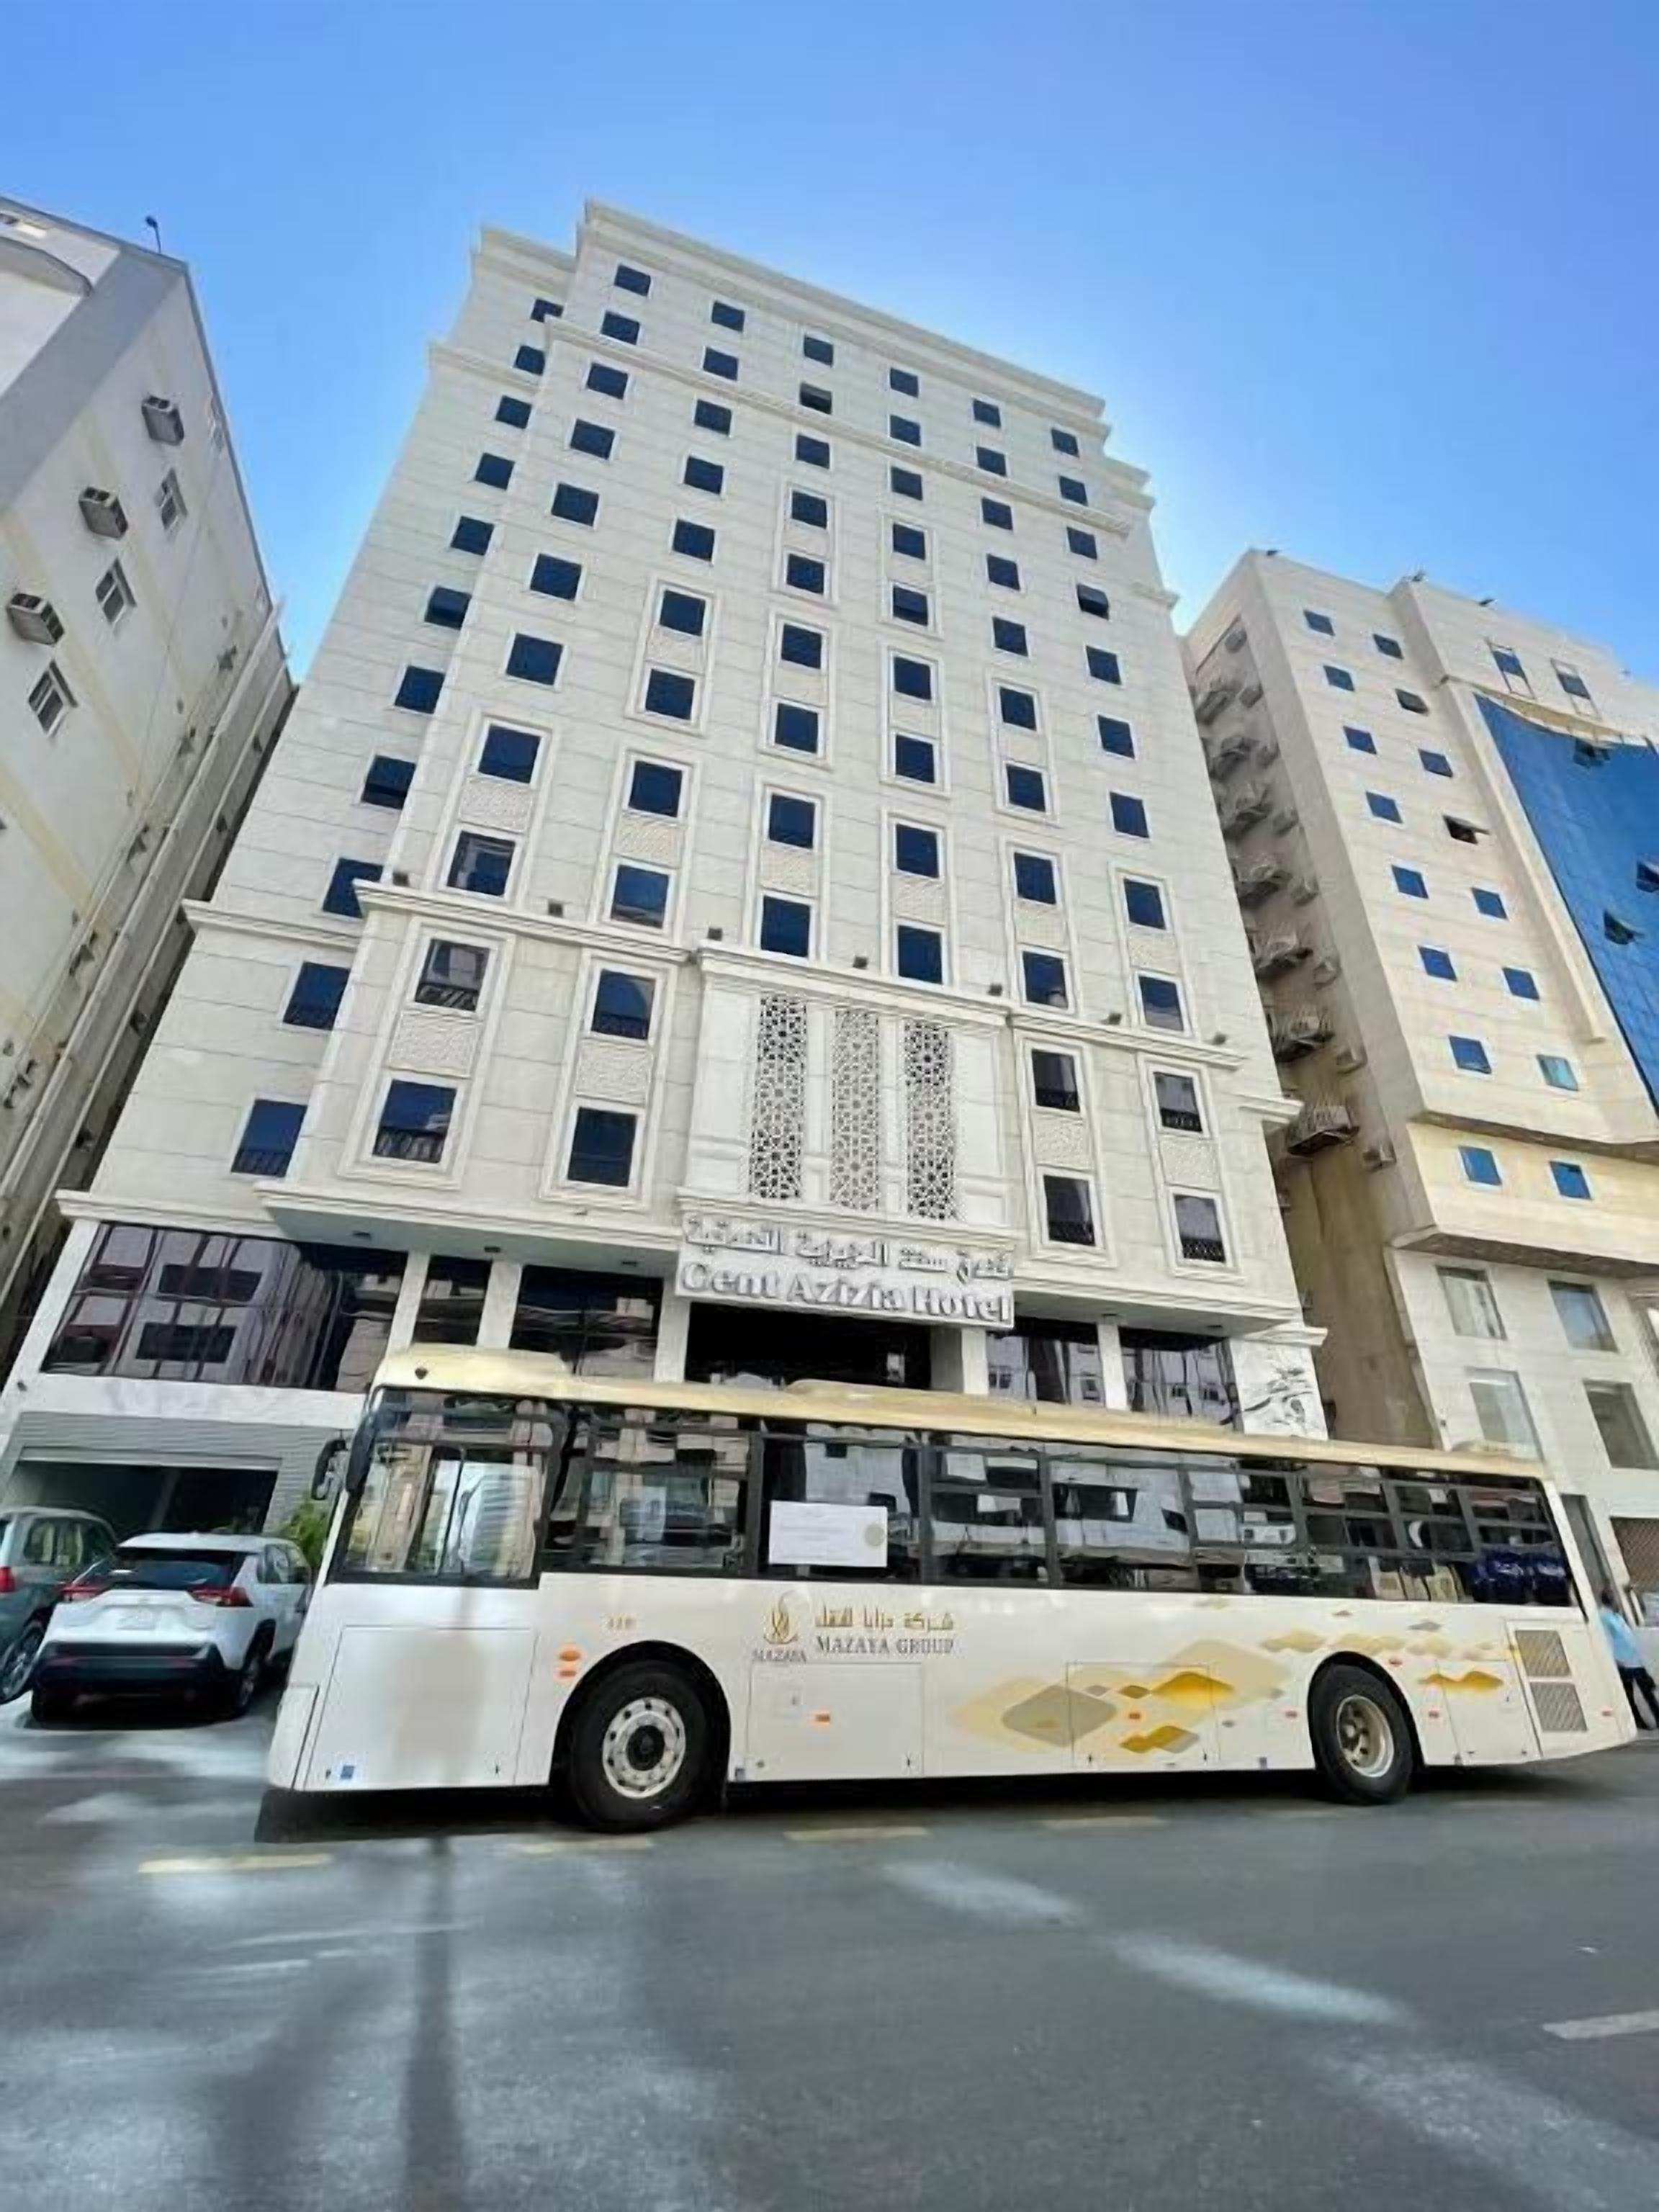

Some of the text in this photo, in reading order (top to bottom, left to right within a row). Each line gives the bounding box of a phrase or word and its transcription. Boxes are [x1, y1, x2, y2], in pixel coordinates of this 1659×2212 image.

[789, 1272, 904, 1311] Azizia
[912, 1283, 1011, 1322] Hotel
[817, 1635, 954, 1655] MAZAYA GROUP
